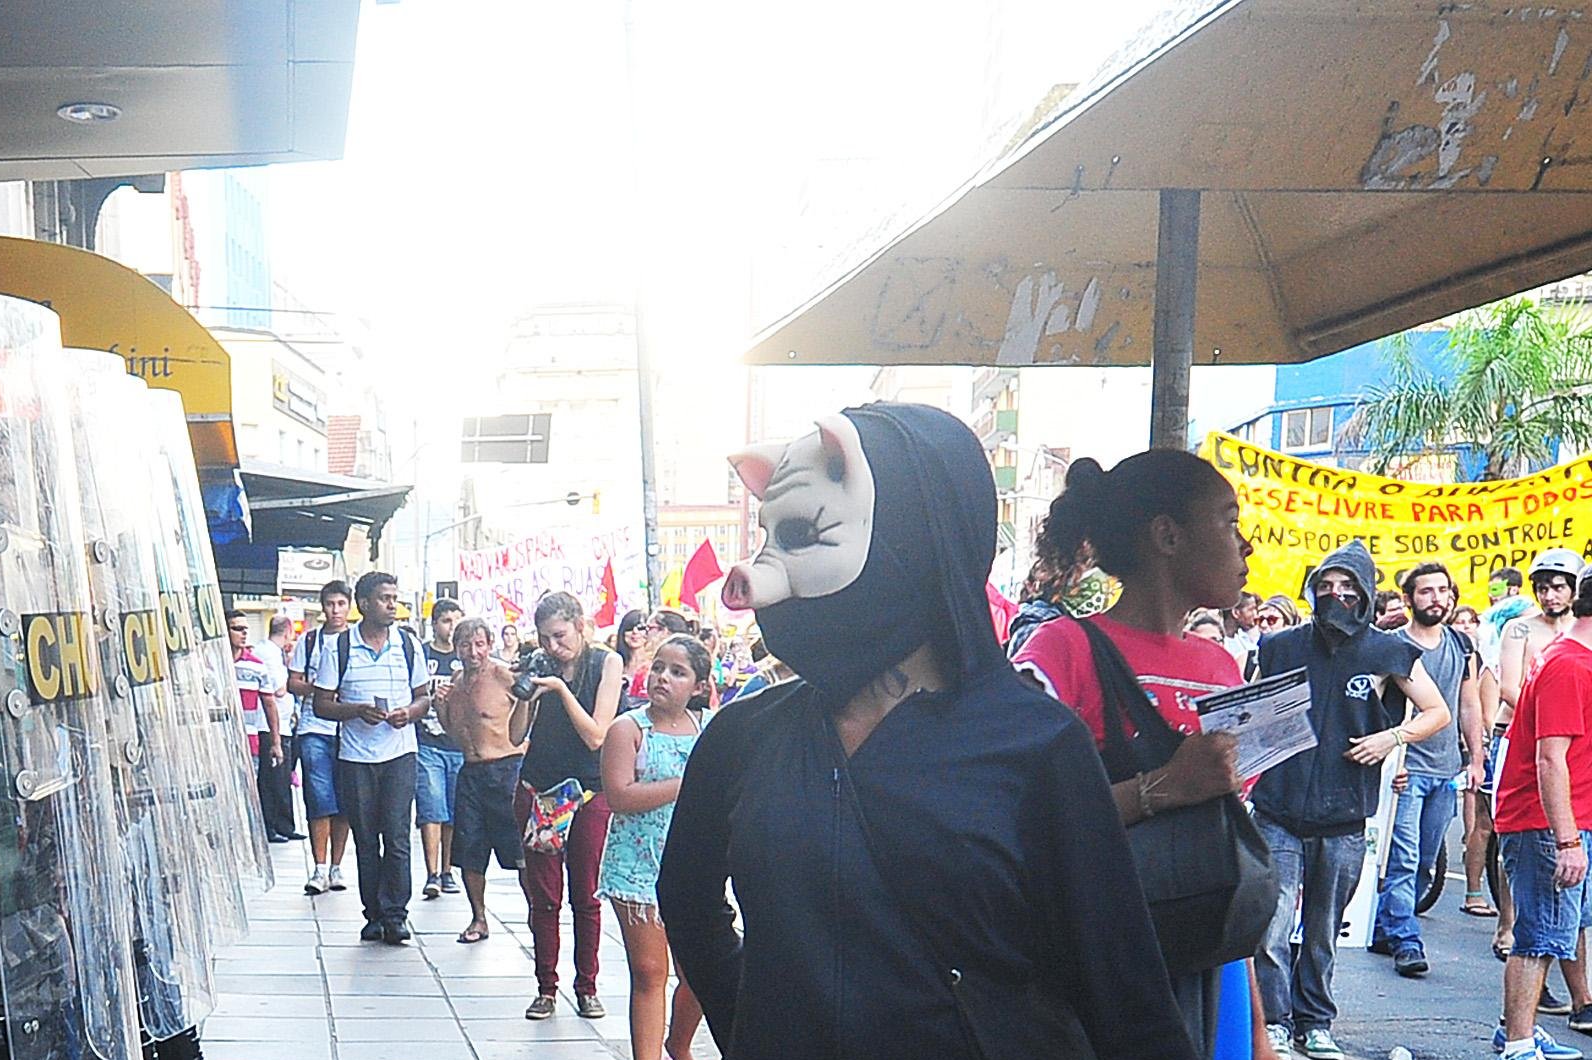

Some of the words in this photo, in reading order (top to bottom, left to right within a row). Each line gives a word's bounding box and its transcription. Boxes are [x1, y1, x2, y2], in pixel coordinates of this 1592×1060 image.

[110, 344, 173, 378] ini
[1215, 437, 1357, 491] CONTRA
[1237, 484, 1394, 521] ASSE-LIVRE
[1411, 502, 1484, 522] PARA
[1493, 478, 1592, 519] TODOS
[1395, 535, 1439, 554] SOB
[1451, 518, 1574, 551] CONTROLE
